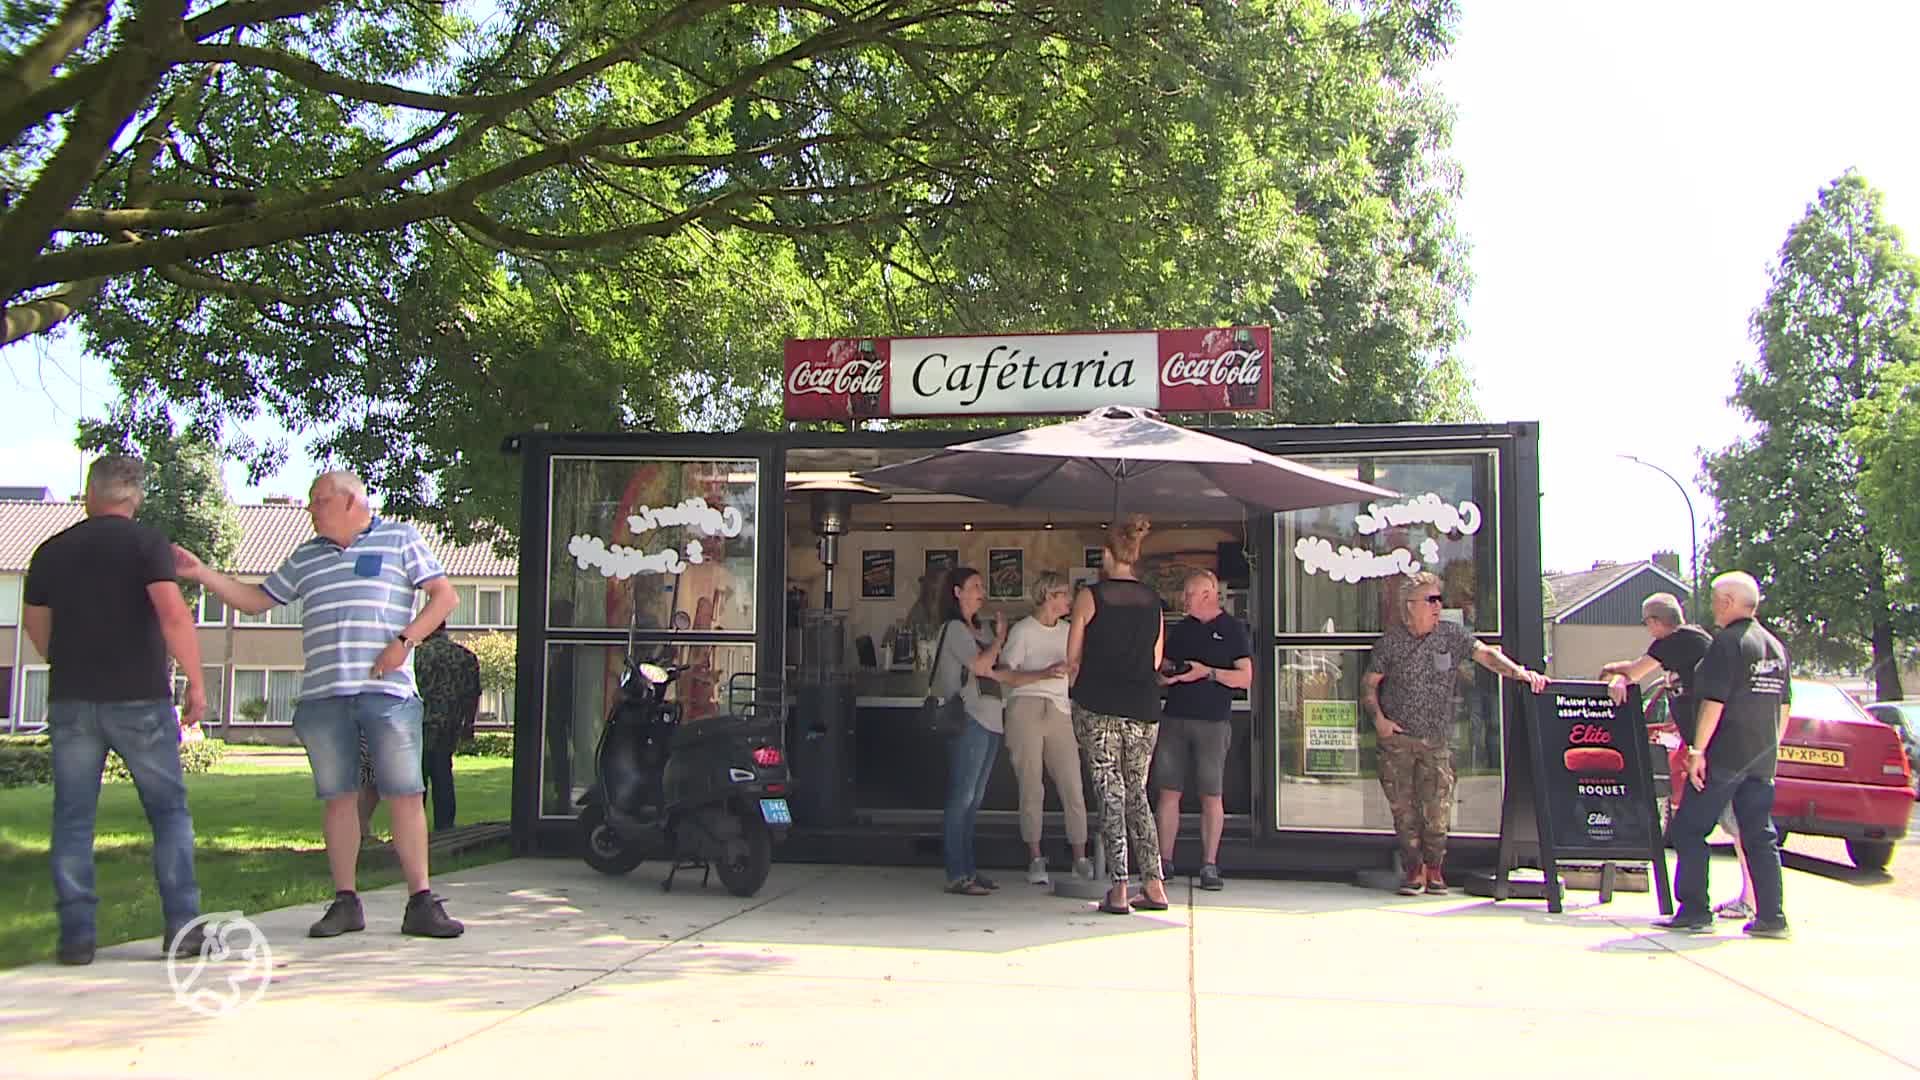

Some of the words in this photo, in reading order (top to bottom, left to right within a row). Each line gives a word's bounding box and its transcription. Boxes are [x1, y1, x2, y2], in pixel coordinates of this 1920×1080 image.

[788, 359, 887, 394] Coca-Cola
[912, 345, 1137, 406] Cafétaria
[1161, 349, 1265, 387] Coca-Cola
[1556, 695, 1587, 706] Nieuw
[1587, 697, 1597, 706] in
[1569, 723, 1611, 744] Elite
[1780, 747, 1840, 764] TV-XP-50
[1578, 785, 1626, 796] ROQUET
[1587, 812, 1612, 825] Elite
